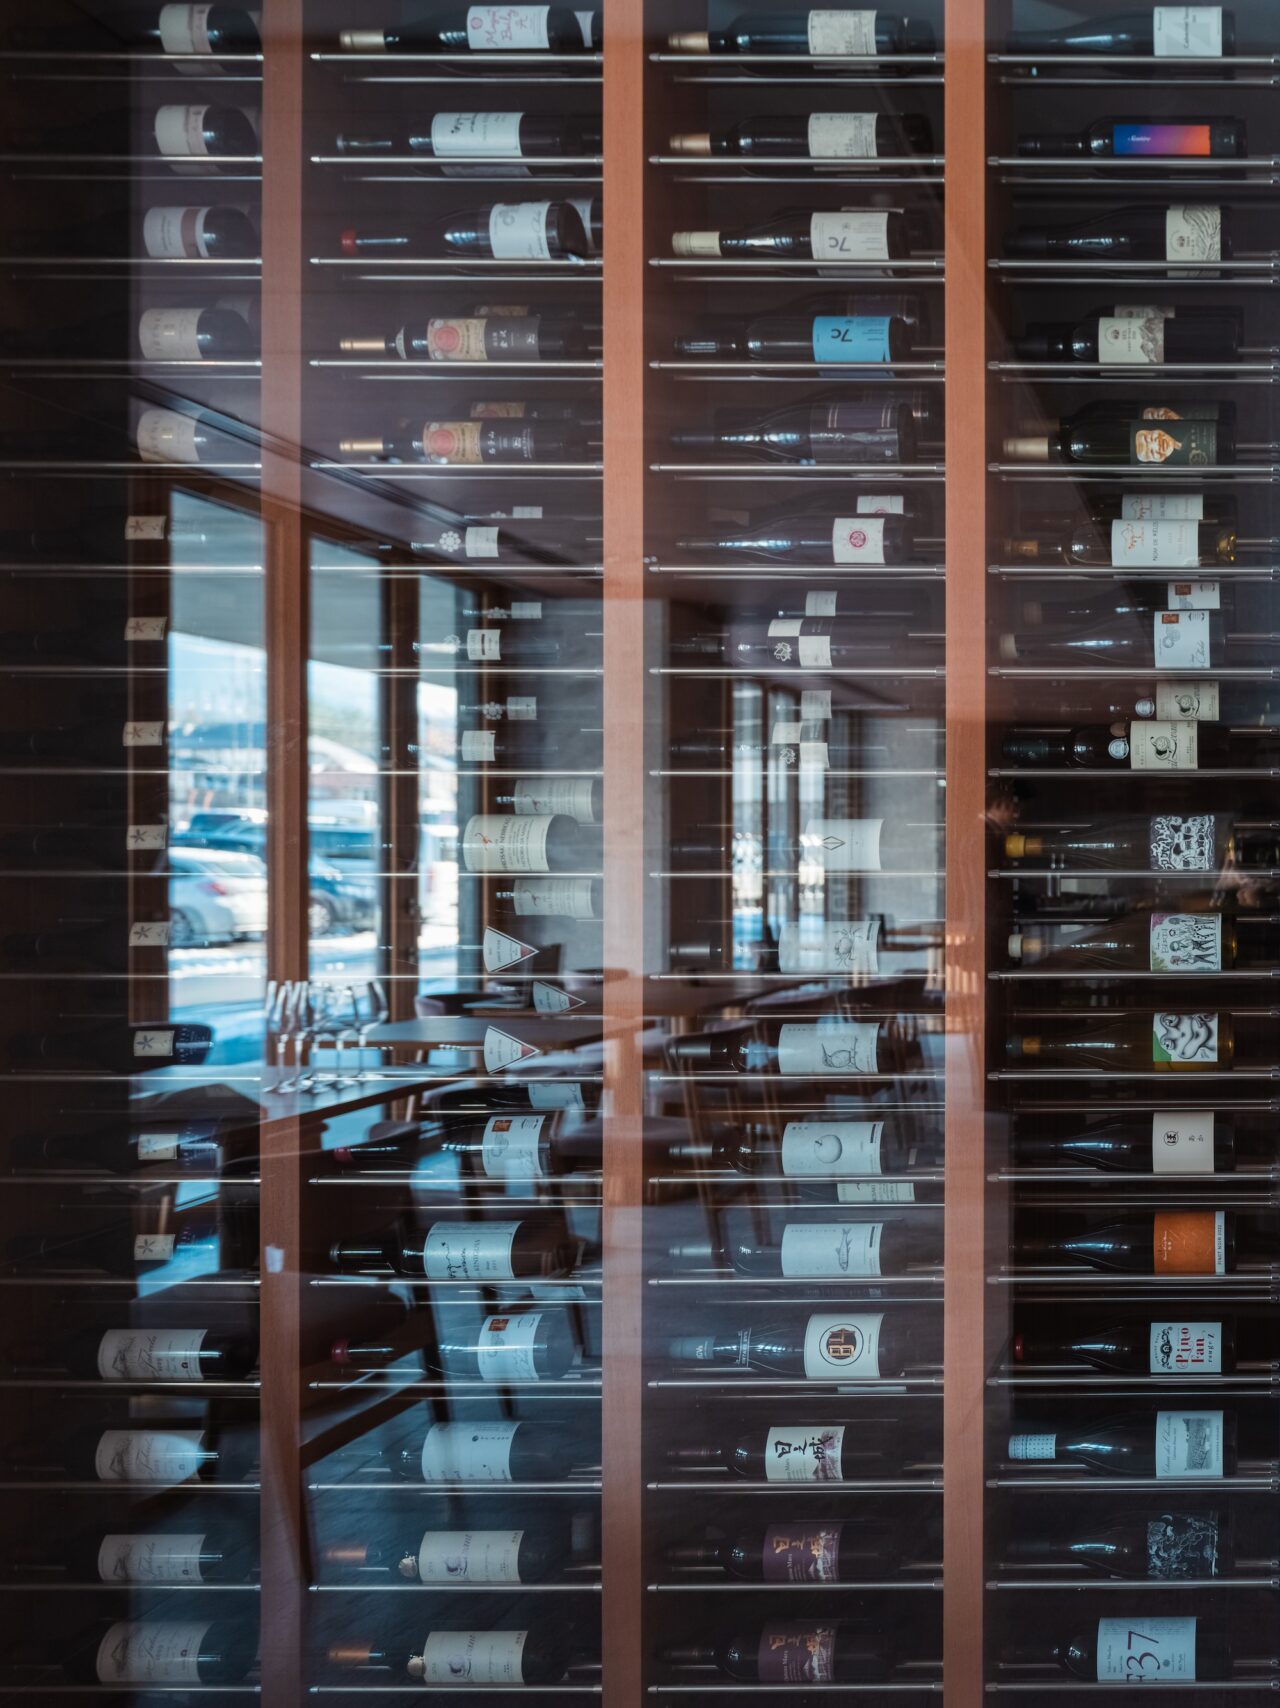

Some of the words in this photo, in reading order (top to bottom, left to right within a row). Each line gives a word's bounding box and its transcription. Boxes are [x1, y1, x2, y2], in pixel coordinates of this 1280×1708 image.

[828, 236, 851, 252] 7c
[830, 328, 853, 343] 7c
[1165, 1133, 1178, 1145] ほ
[1191, 1338, 1205, 1363] Fan
[774, 1435, 833, 1463] 日之城
